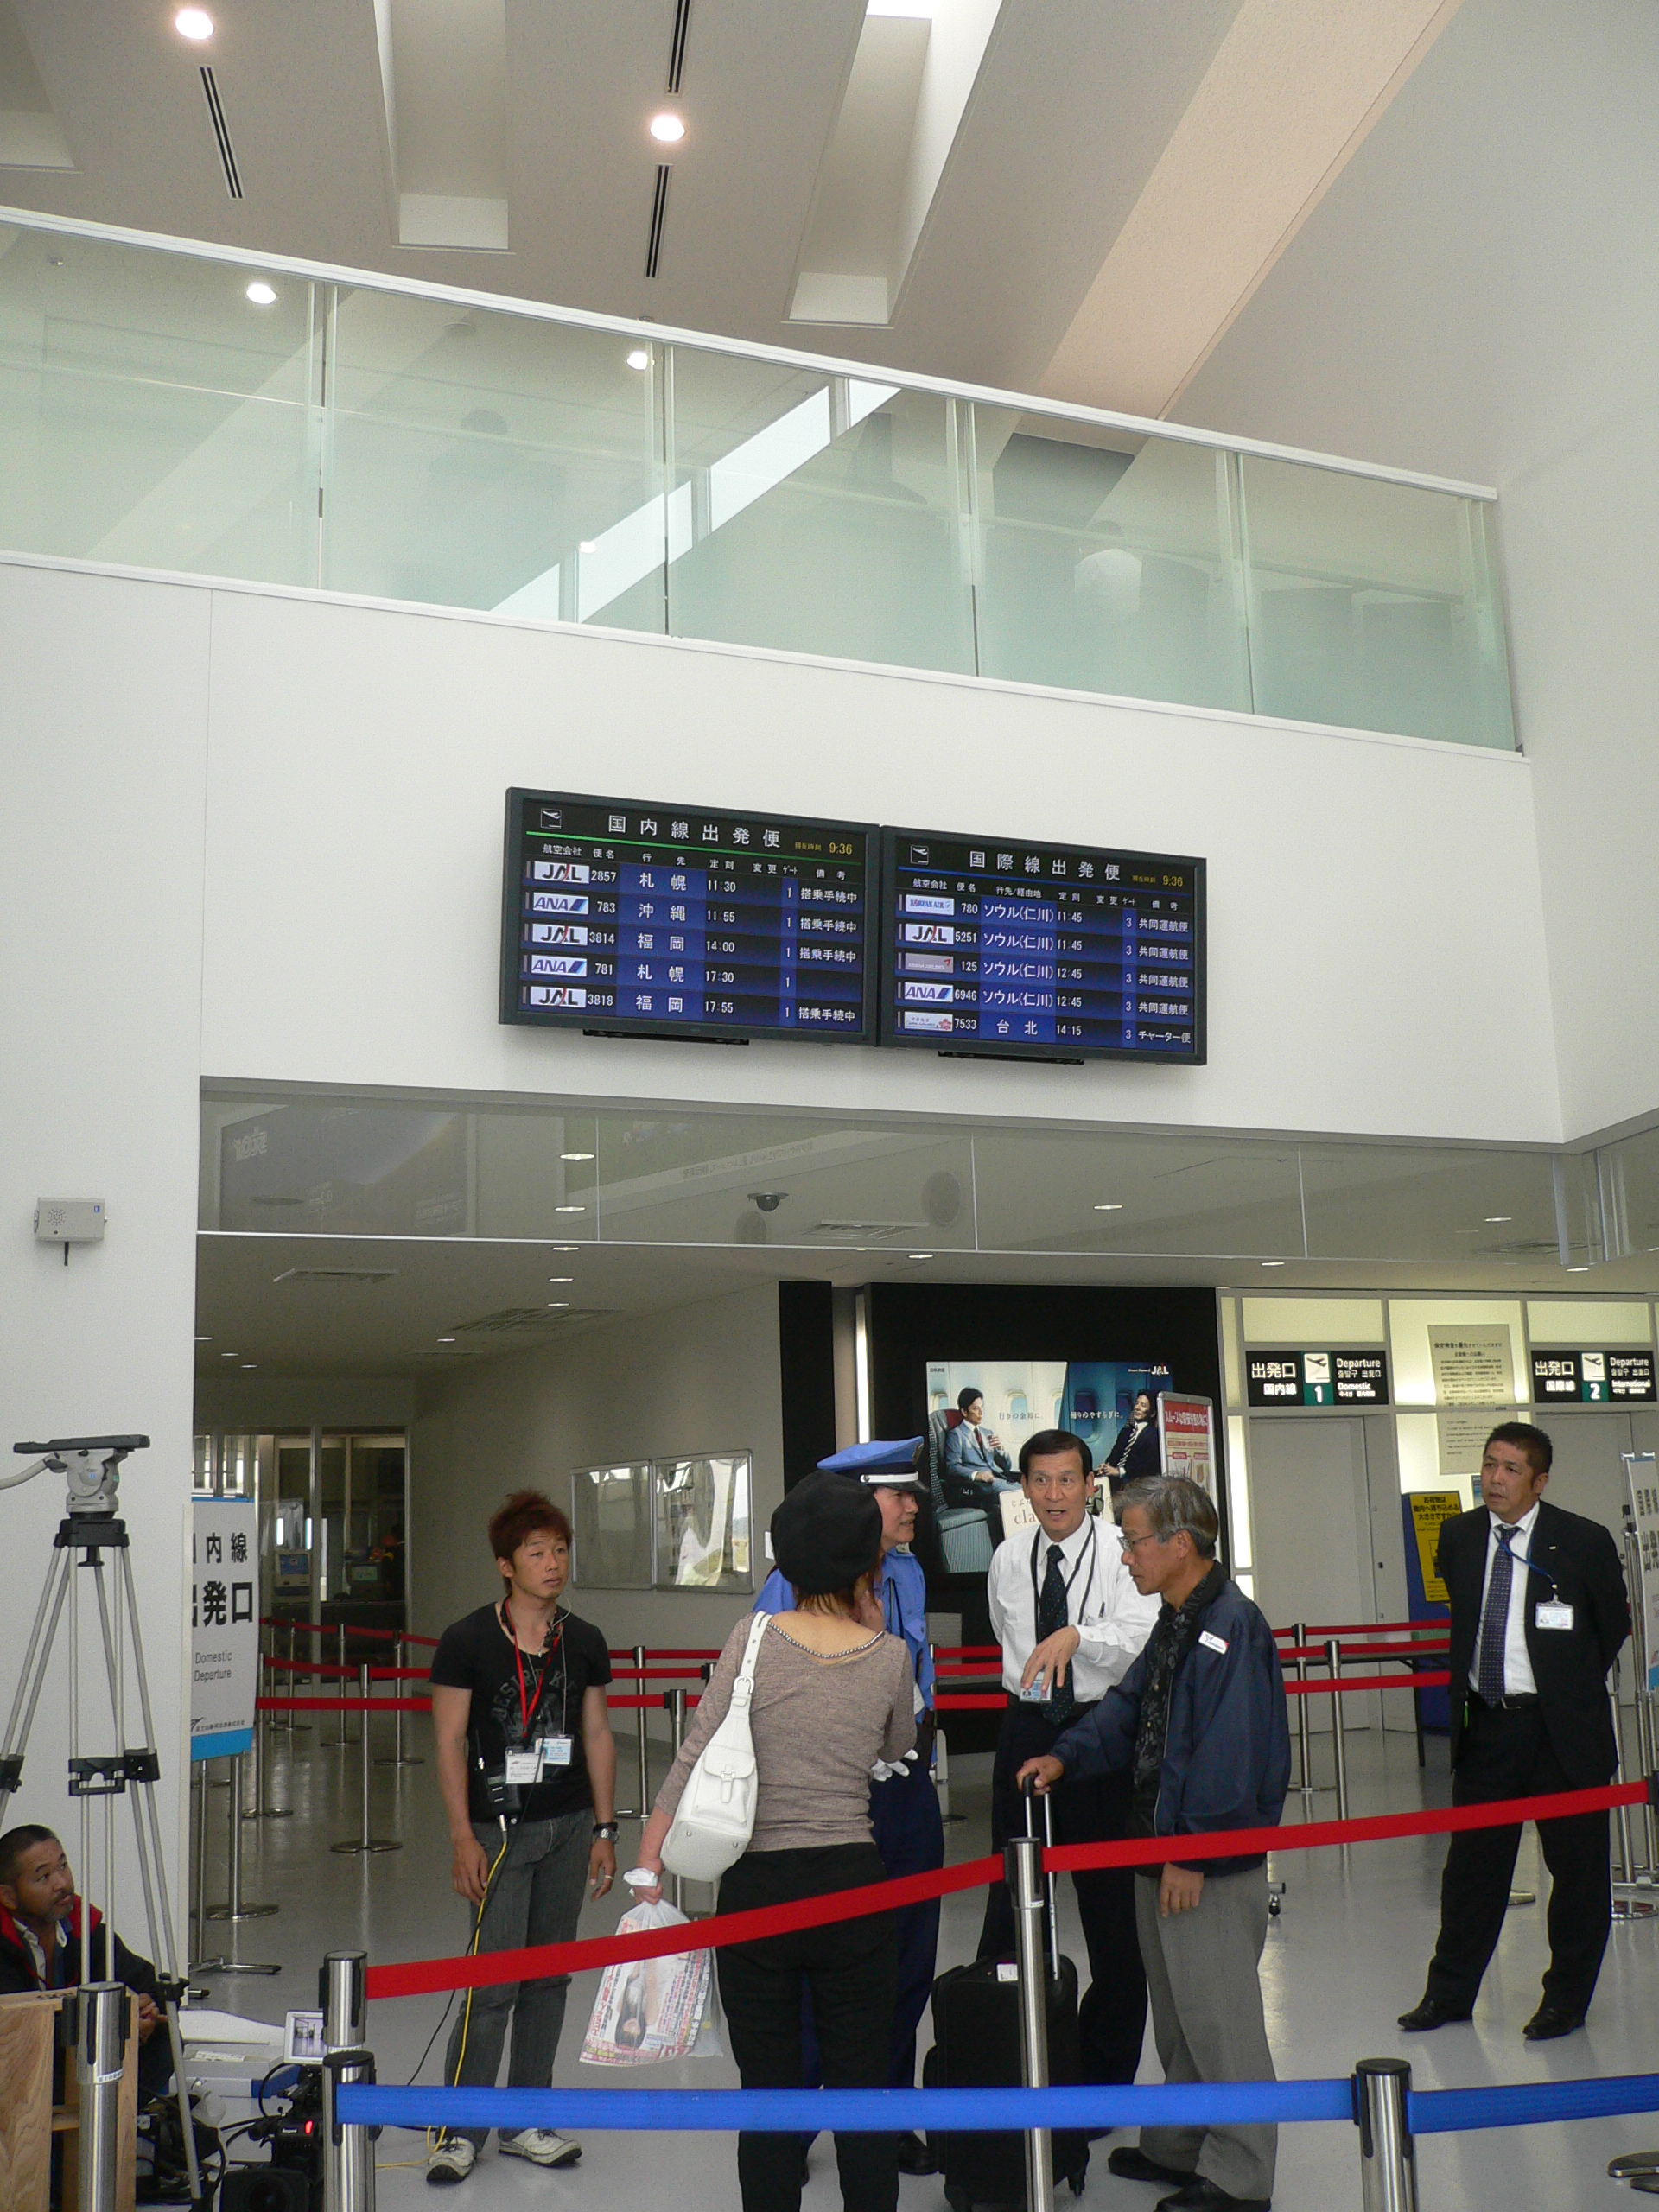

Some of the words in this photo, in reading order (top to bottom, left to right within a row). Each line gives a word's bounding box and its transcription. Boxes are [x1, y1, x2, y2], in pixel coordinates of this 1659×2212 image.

[608, 814, 781, 849] 国内線出発便
[829, 842, 853, 855] 9:36
[543, 843, 582, 857] 航空会社
[593, 848, 615, 859] 便名
[642, 853, 686, 866] 行先
[753, 862, 778, 874] 変更
[969, 850, 1121, 881] 国際線出発便
[1162, 875, 1184, 887] 9:36
[542, 861, 582, 881] JAL
[591, 870, 617, 883] 2857
[639, 872, 687, 891] 札幌
[707, 879, 736, 893] 11:30
[787, 887, 792, 899] 1
[800, 887, 857, 904] 搭乗手続中
[912, 877, 948, 890] 航空会社
[957, 881, 976, 893] 便名
[1096, 894, 1119, 906] 変更
[534, 896, 569, 912] ANA
[596, 900, 616, 914] 783
[639, 903, 686, 921] 沖縄
[707, 910, 735, 923] 11:55
[786, 917, 791, 928] 1
[800, 916, 857, 933] 搭乗手続中
[961, 902, 978, 914] 780
[983, 903, 1054, 923] ソウル(仁川)
[1057, 910, 1083, 924] 11:45
[1126, 917, 1132, 928] 3
[1139, 918, 1189, 933] 共同運航便
[540, 925, 581, 944] JAL
[588, 931, 615, 944] 3814
[637, 932, 684, 951] 福岡
[706, 940, 735, 953] 14:00
[785, 947, 791, 958] 1
[799, 947, 856, 963] 搭乗手続中
[912, 925, 948, 943] JAL
[955, 931, 977, 944] 5251
[983, 931, 1054, 950] ソウル(仁川)
[1057, 938, 1083, 951] 11:45
[1126, 944, 1132, 956] 3
[1138, 945, 1189, 961] 共同運航便
[532, 959, 567, 974] ANA
[594, 963, 613, 975] 781
[637, 963, 685, 982] 札幌
[705, 970, 734, 983] 17:30
[785, 976, 790, 988] 1
[961, 961, 978, 972] 125
[983, 961, 1054, 980] ソウル(仁川)
[1057, 967, 1083, 980] 12:45
[1126, 973, 1132, 983] 3
[1138, 974, 1189, 988] 共同運航便
[538, 987, 579, 1006] JAL
[588, 994, 613, 1007] 3818
[635, 995, 683, 1013] 福岡
[704, 1001, 734, 1014] 17:55
[785, 1007, 789, 1018] 1
[798, 1007, 855, 1023] 搭乗手続中
[905, 986, 936, 999] ANA
[954, 988, 977, 1001] 6946
[982, 989, 1054, 1008] ソウル(仁川)
[1056, 995, 1082, 1008] 12:45
[1125, 1001, 1132, 1012] 3
[1138, 1001, 1189, 1016] 共同運航便
[954, 1018, 977, 1030] 7533
[996, 1019, 1039, 1035] 台北
[1056, 1024, 1082, 1037] 14:15
[1125, 1029, 1132, 1040] 3
[1138, 1029, 1192, 1044] チャーター便
[1151, 1364, 1170, 1375] JAL
[1251, 1362, 1296, 1379] 出発口
[1336, 1357, 1381, 1370] Departure
[1535, 1360, 1575, 1376] 出発口
[1610, 1357, 1649, 1368] Departure
[1262, 1382, 1297, 1396] 国内線
[1313, 1384, 1323, 1403] 1
[1338, 1382, 1372, 1390] Domestic
[1590, 1382, 1601, 1400] 2
[1611, 1379, 1651, 1388] International
[193, 1532, 248, 1565] 内線
[194, 1649, 232, 1665] Domestic
[194, 1668, 232, 1682] Departure
